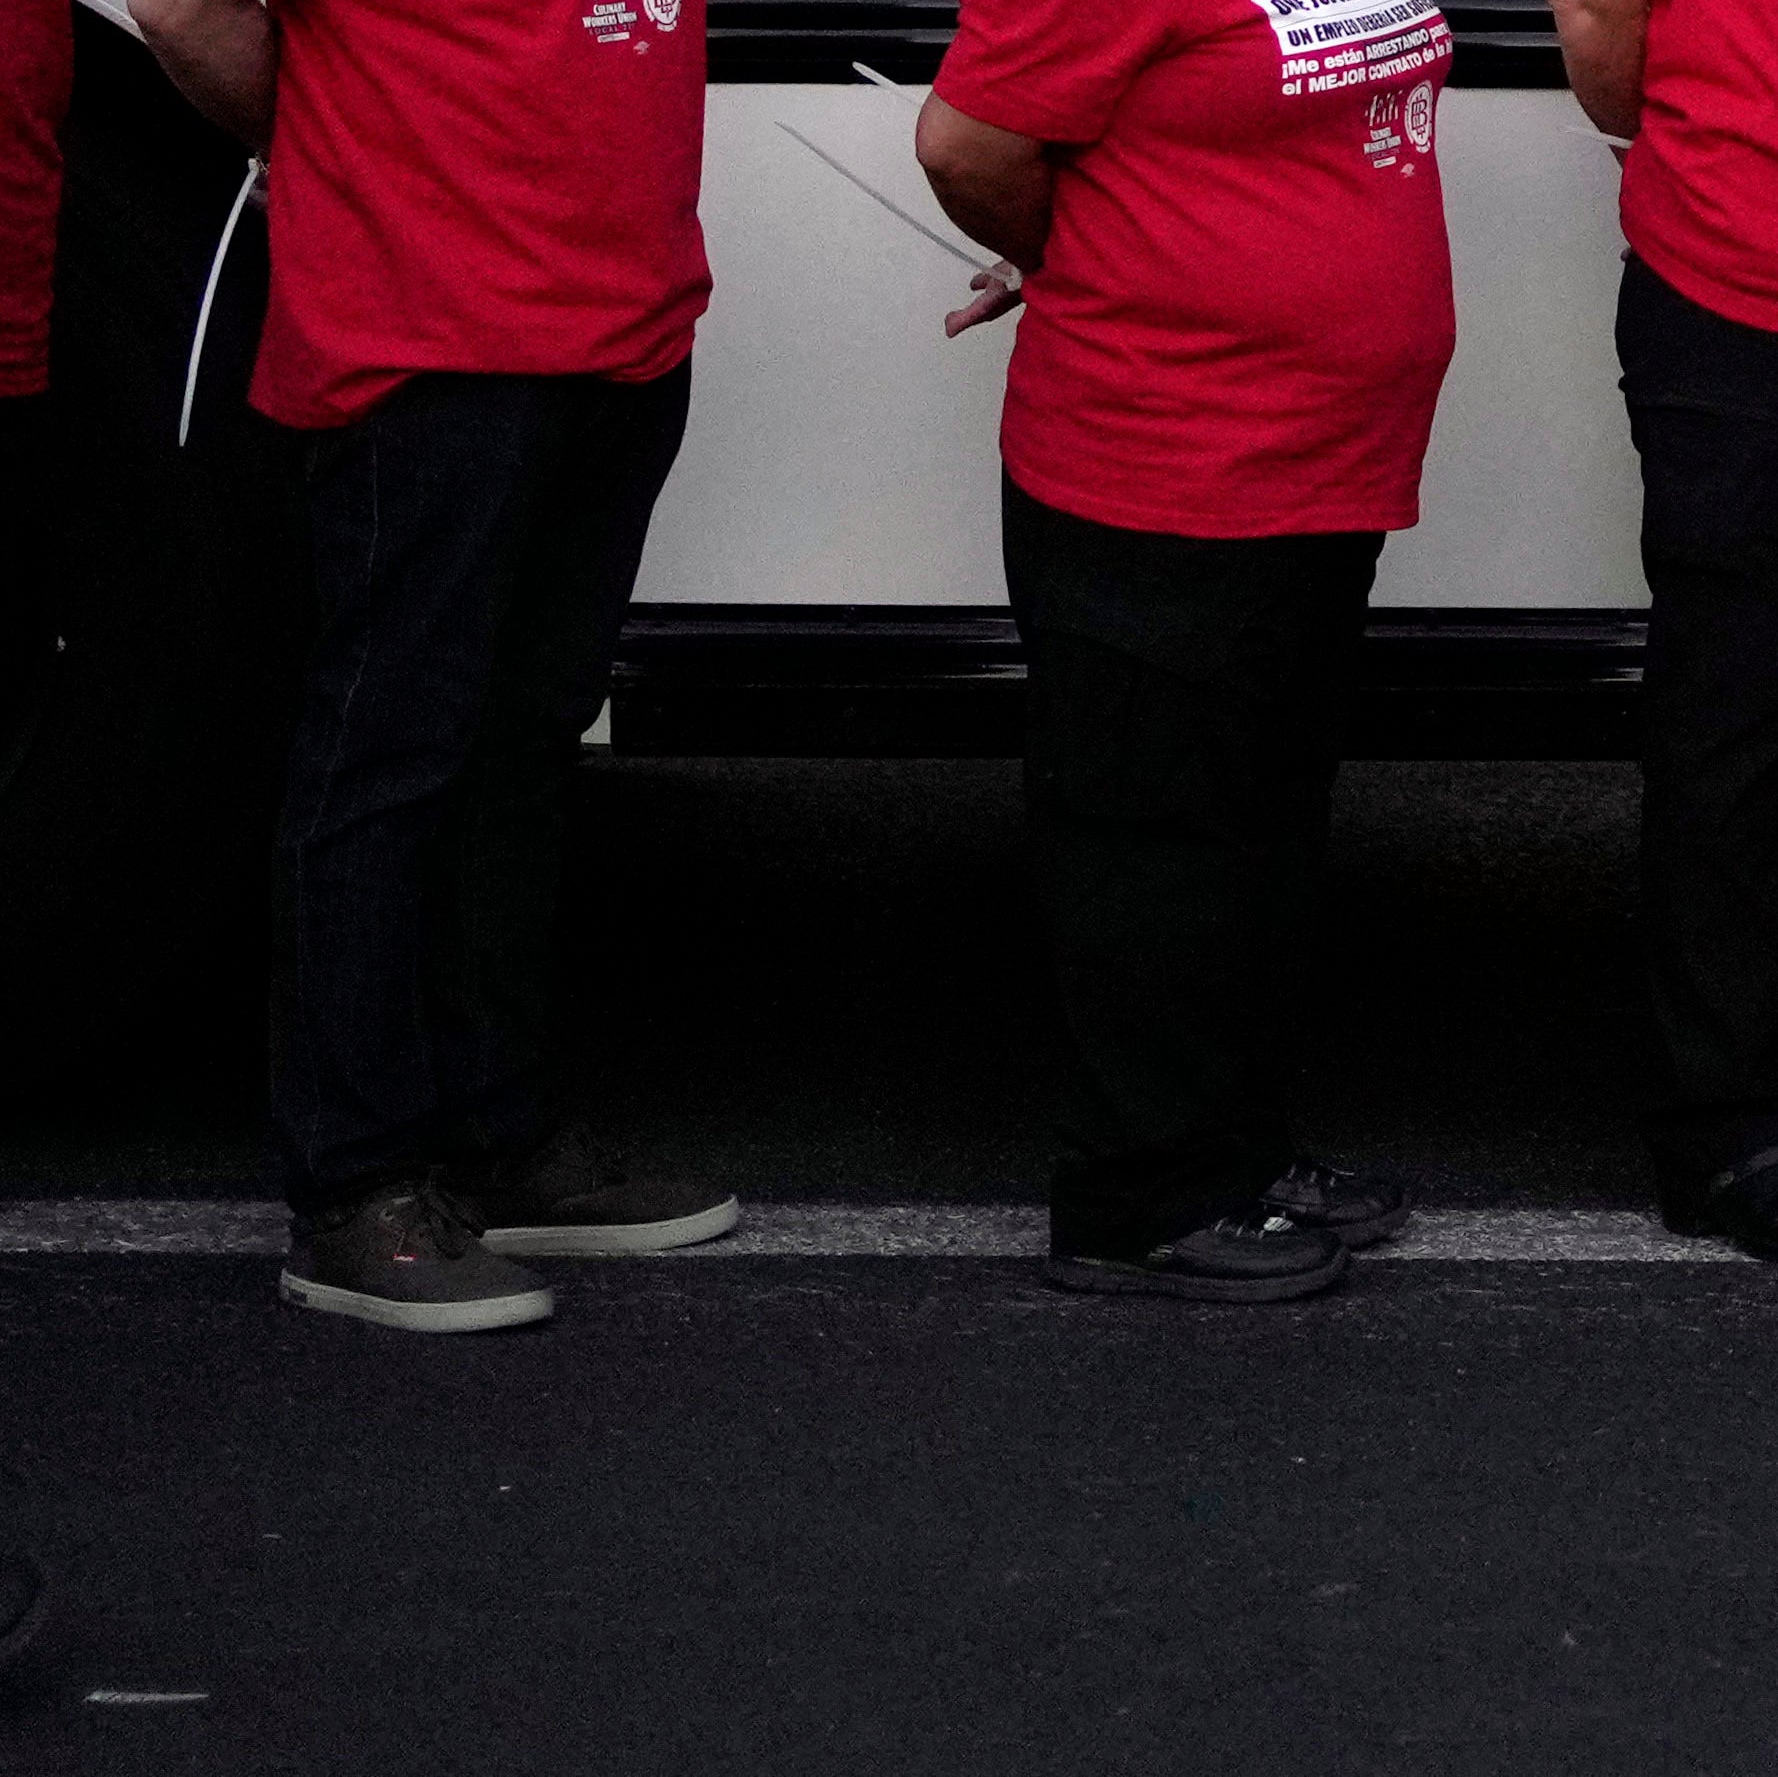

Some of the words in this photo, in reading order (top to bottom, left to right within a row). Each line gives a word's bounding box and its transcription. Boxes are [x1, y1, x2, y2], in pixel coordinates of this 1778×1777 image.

[1287, 28, 1313, 47] UN
[1323, 48, 1365, 69] están
[1365, 28, 1429, 60] ARRESTANDO
[1281, 79, 1302, 96] el
[1308, 69, 1366, 94] MEJOR
[1368, 52, 1423, 80] CONTRATO
[1422, 47, 1436, 63] de
